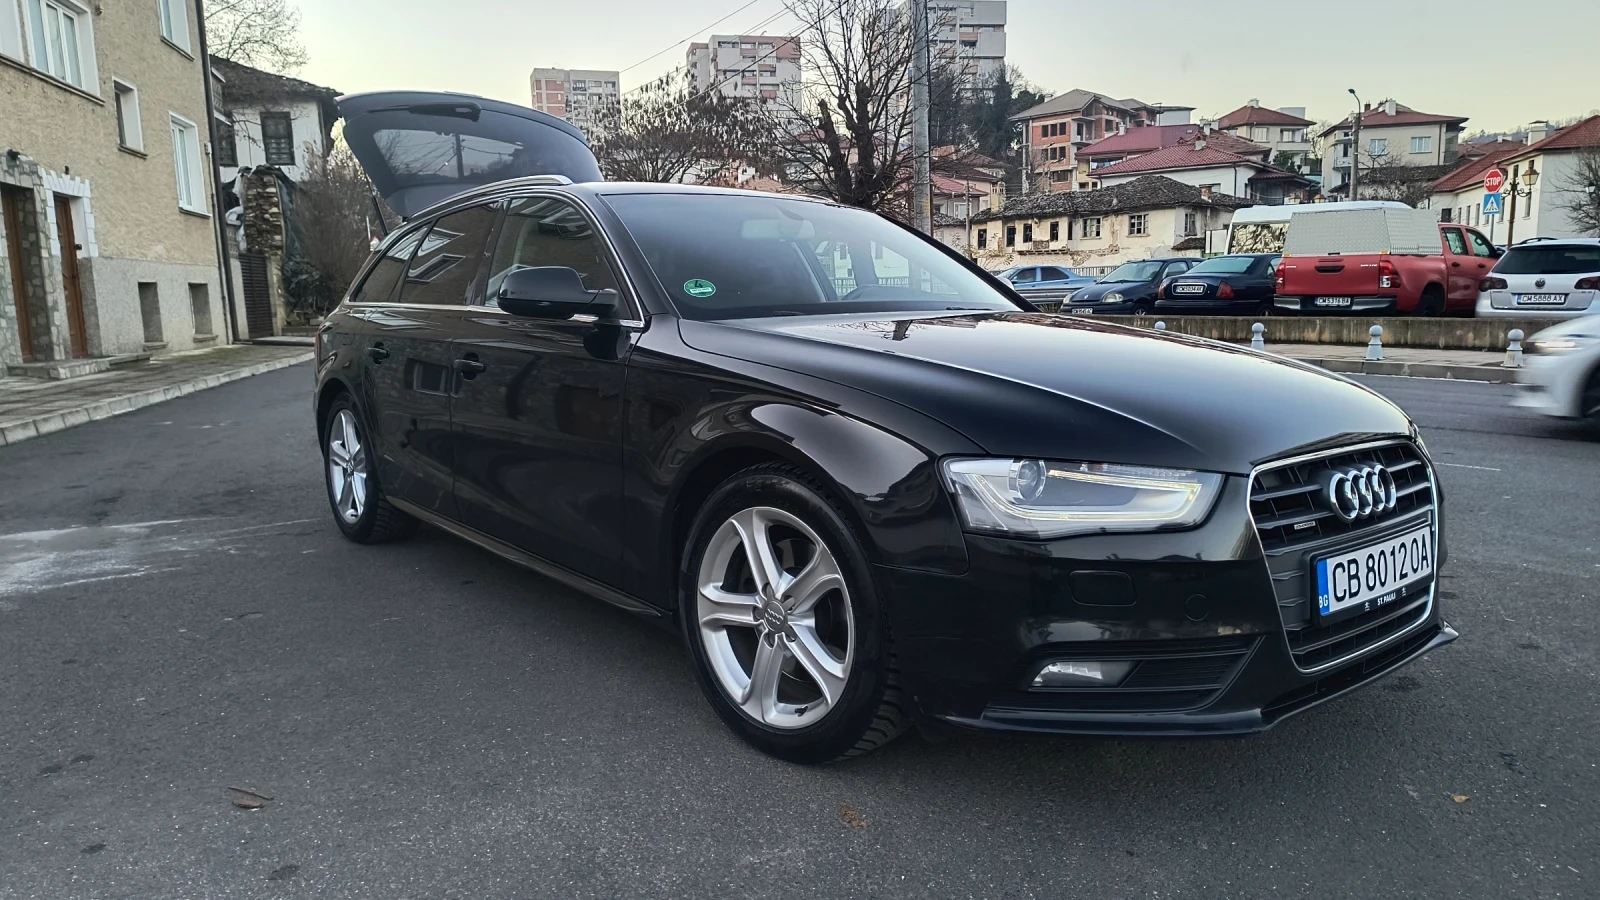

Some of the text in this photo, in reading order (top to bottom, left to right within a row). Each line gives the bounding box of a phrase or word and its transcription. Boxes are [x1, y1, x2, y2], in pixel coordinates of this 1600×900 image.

[1486, 176, 1500, 186] STOP
[1332, 533, 1430, 603] CB 8012 OA
[1319, 594, 1328, 608] BG
